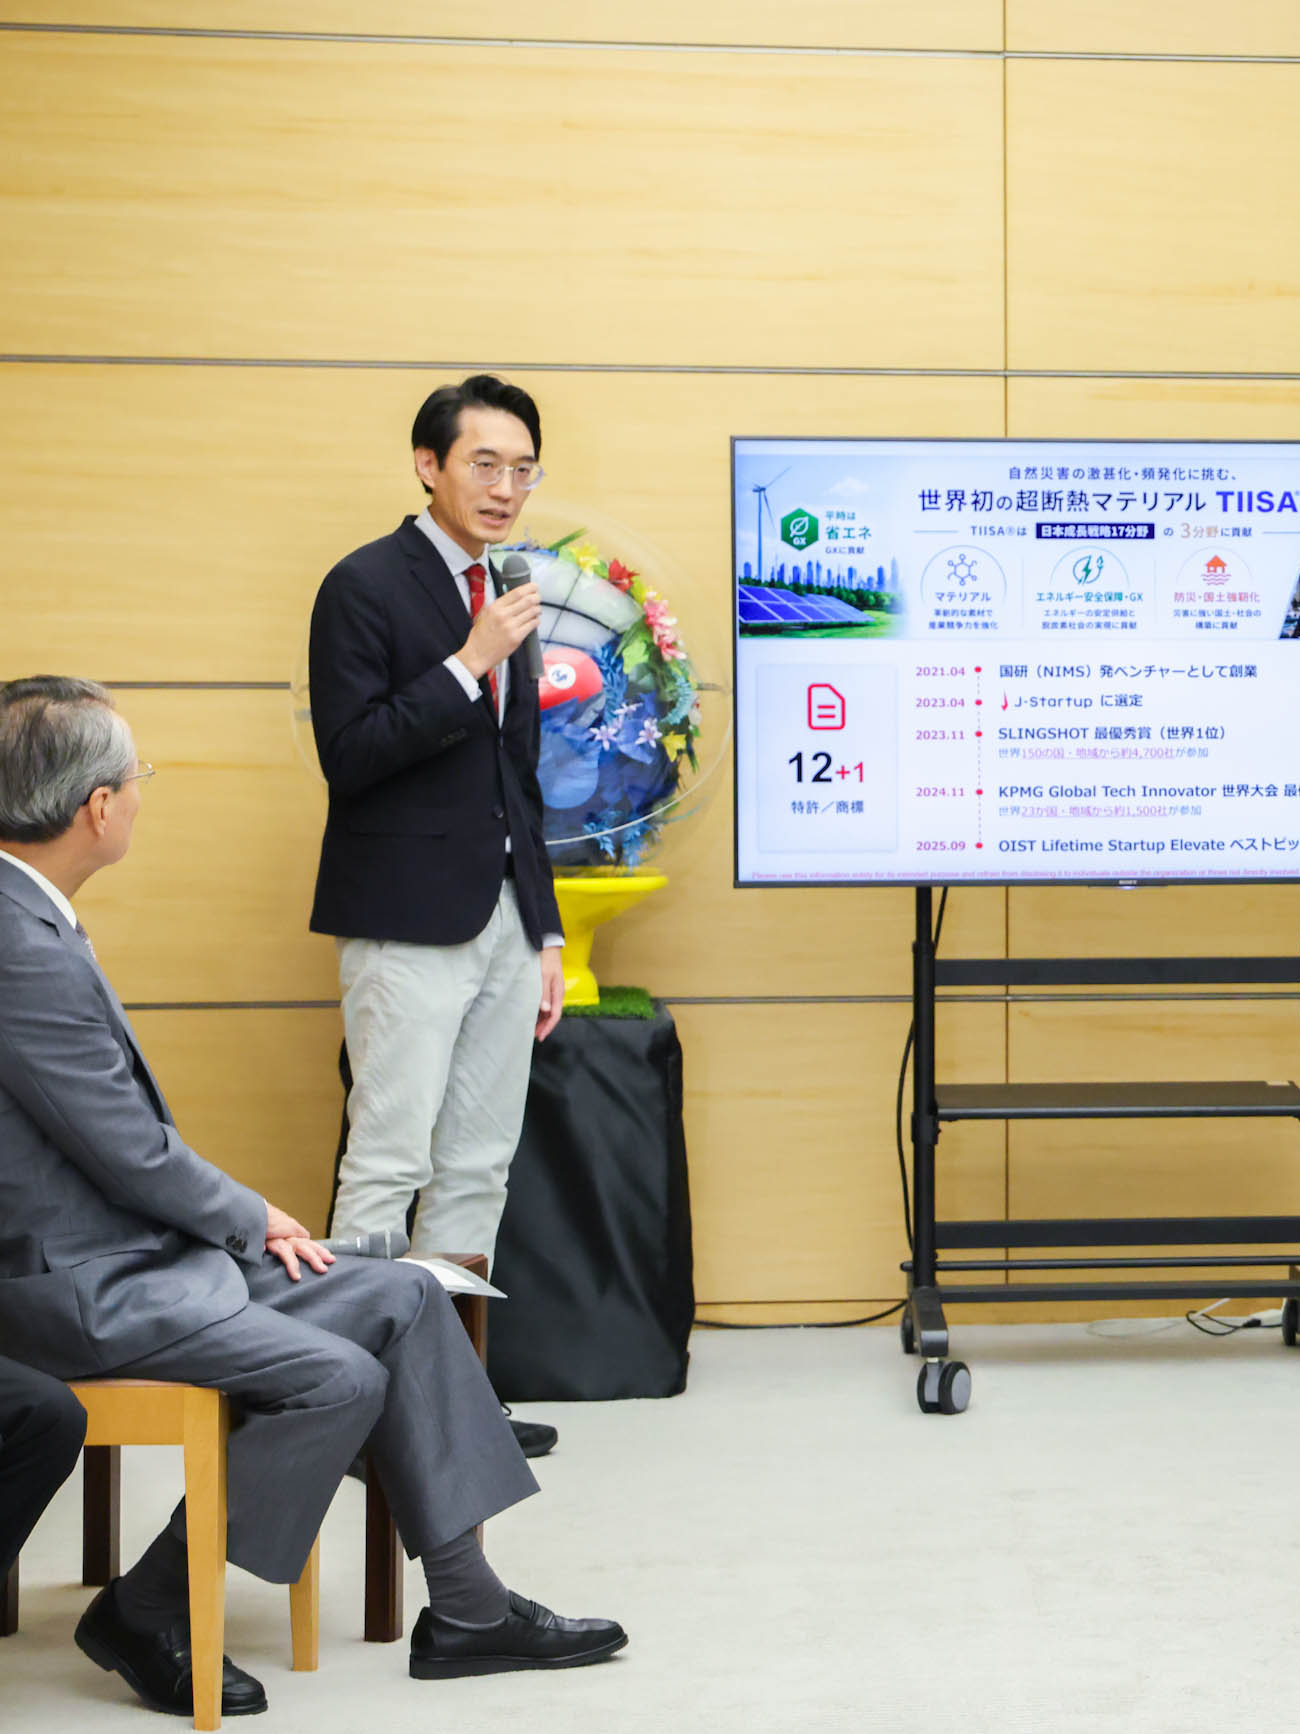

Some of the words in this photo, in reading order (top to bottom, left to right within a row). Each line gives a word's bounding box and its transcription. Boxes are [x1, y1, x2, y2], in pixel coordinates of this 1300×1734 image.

[1009, 467, 1236, 480] 自然災害の激甚化・頻発化に挑む、
[919, 490, 1206, 512] 世界初の超断熱マテリアル
[826, 526, 871, 540] 省エネ
[792, 537, 807, 546] GX
[936, 592, 991, 602] マテリアル
[916, 667, 965, 676] 2021.04
[916, 698, 965, 708] 2023.04
[1014, 696, 1093, 708] J-Startup
[1101, 694, 1143, 707] に選定
[916, 730, 964, 740] 2023.11
[999, 728, 1089, 739] SLINGSHOT
[916, 787, 964, 797] 2024.11
[999, 786, 1043, 798] KPMG
[1049, 785, 1096, 798] Global
[1102, 785, 1135, 797] Tech
[1142, 786, 1216, 797] Innovator
[1223, 784, 1278, 797] 世界大会
[916, 841, 966, 851] 2025.09
[999, 840, 1036, 852] OIST
[1042, 840, 1103, 851] Lifetime
[1108, 840, 1165, 853] Startup
[1171, 839, 1225, 851] Elevate
